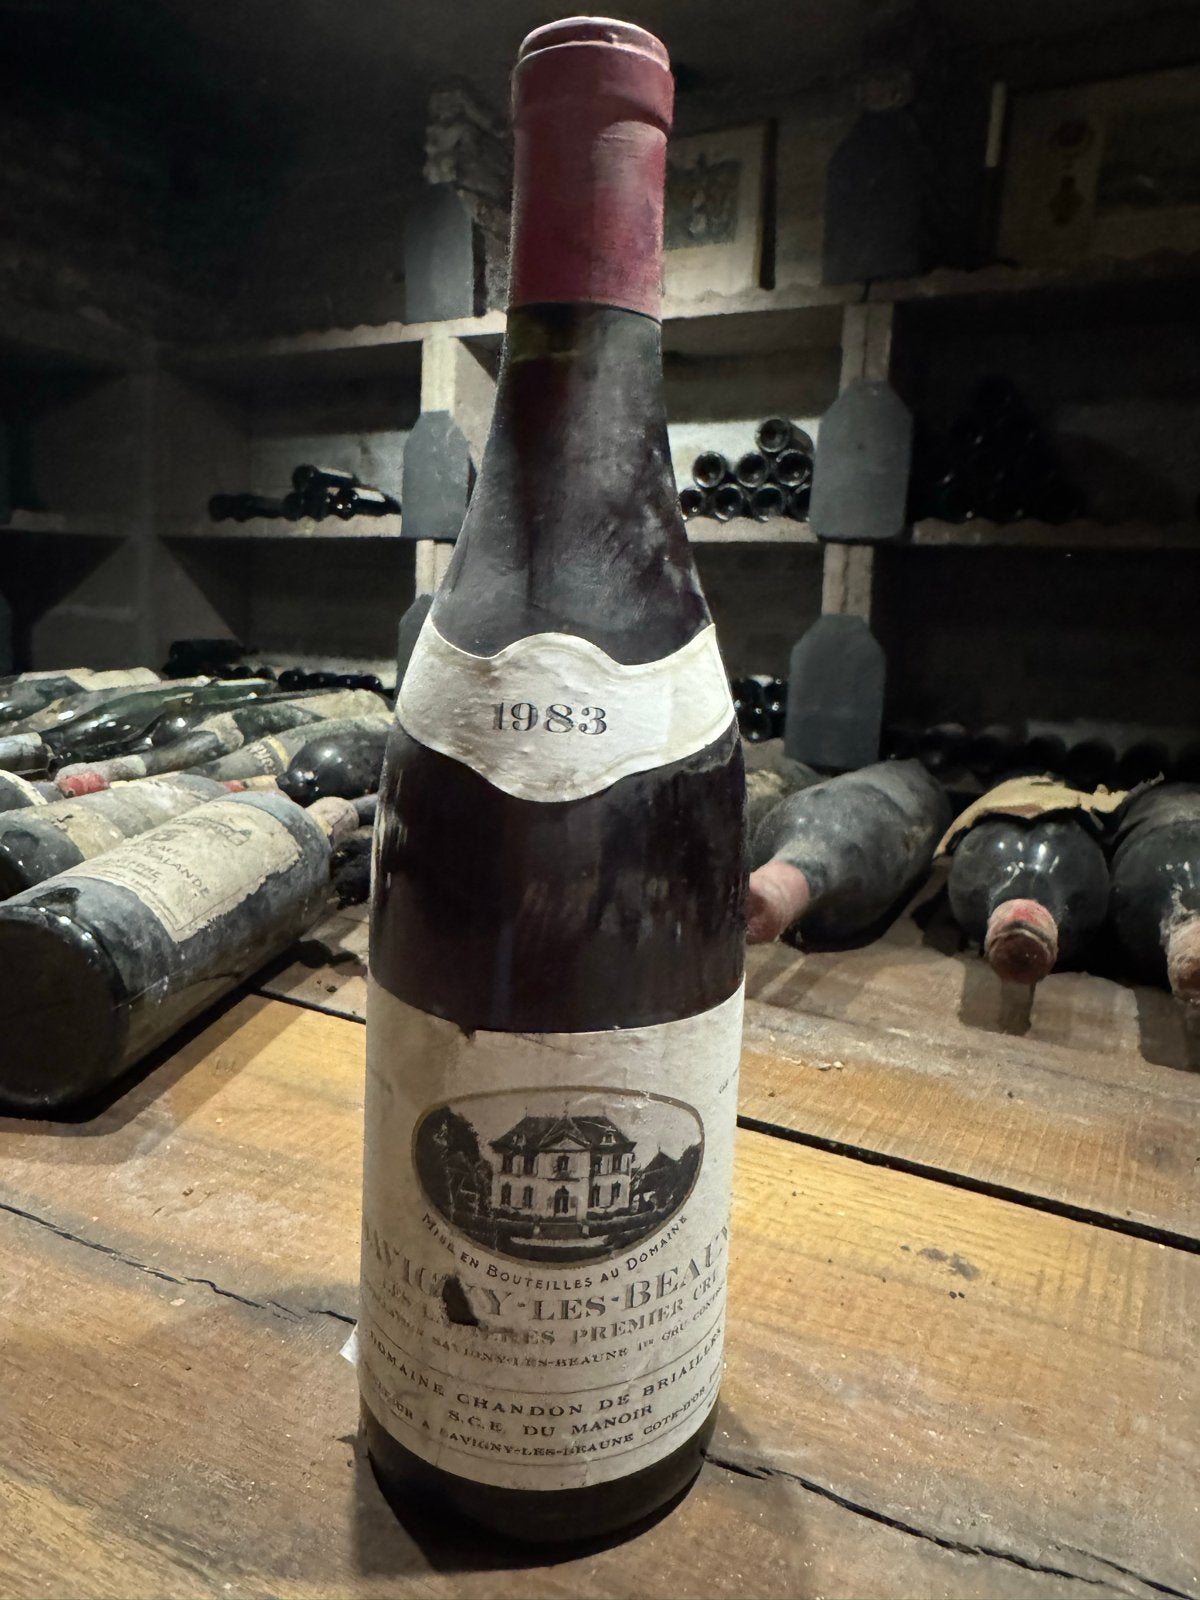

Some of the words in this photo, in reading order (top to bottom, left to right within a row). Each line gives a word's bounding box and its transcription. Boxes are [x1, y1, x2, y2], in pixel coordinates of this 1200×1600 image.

[493, 702, 608, 735] 1983
[460, 1253, 480, 1269] EN
[486, 1263, 593, 1291] BOUTEILLES
[600, 1269, 620, 1284] AU
[625, 1215, 688, 1272] DOMAINE
[573, 1299, 684, 1345] PREMIER
[456, 1393, 583, 1417] CHANDON
[599, 1394, 630, 1411] DE
[523, 1424, 556, 1437] DU
[571, 1404, 653, 1436] MANOIR
